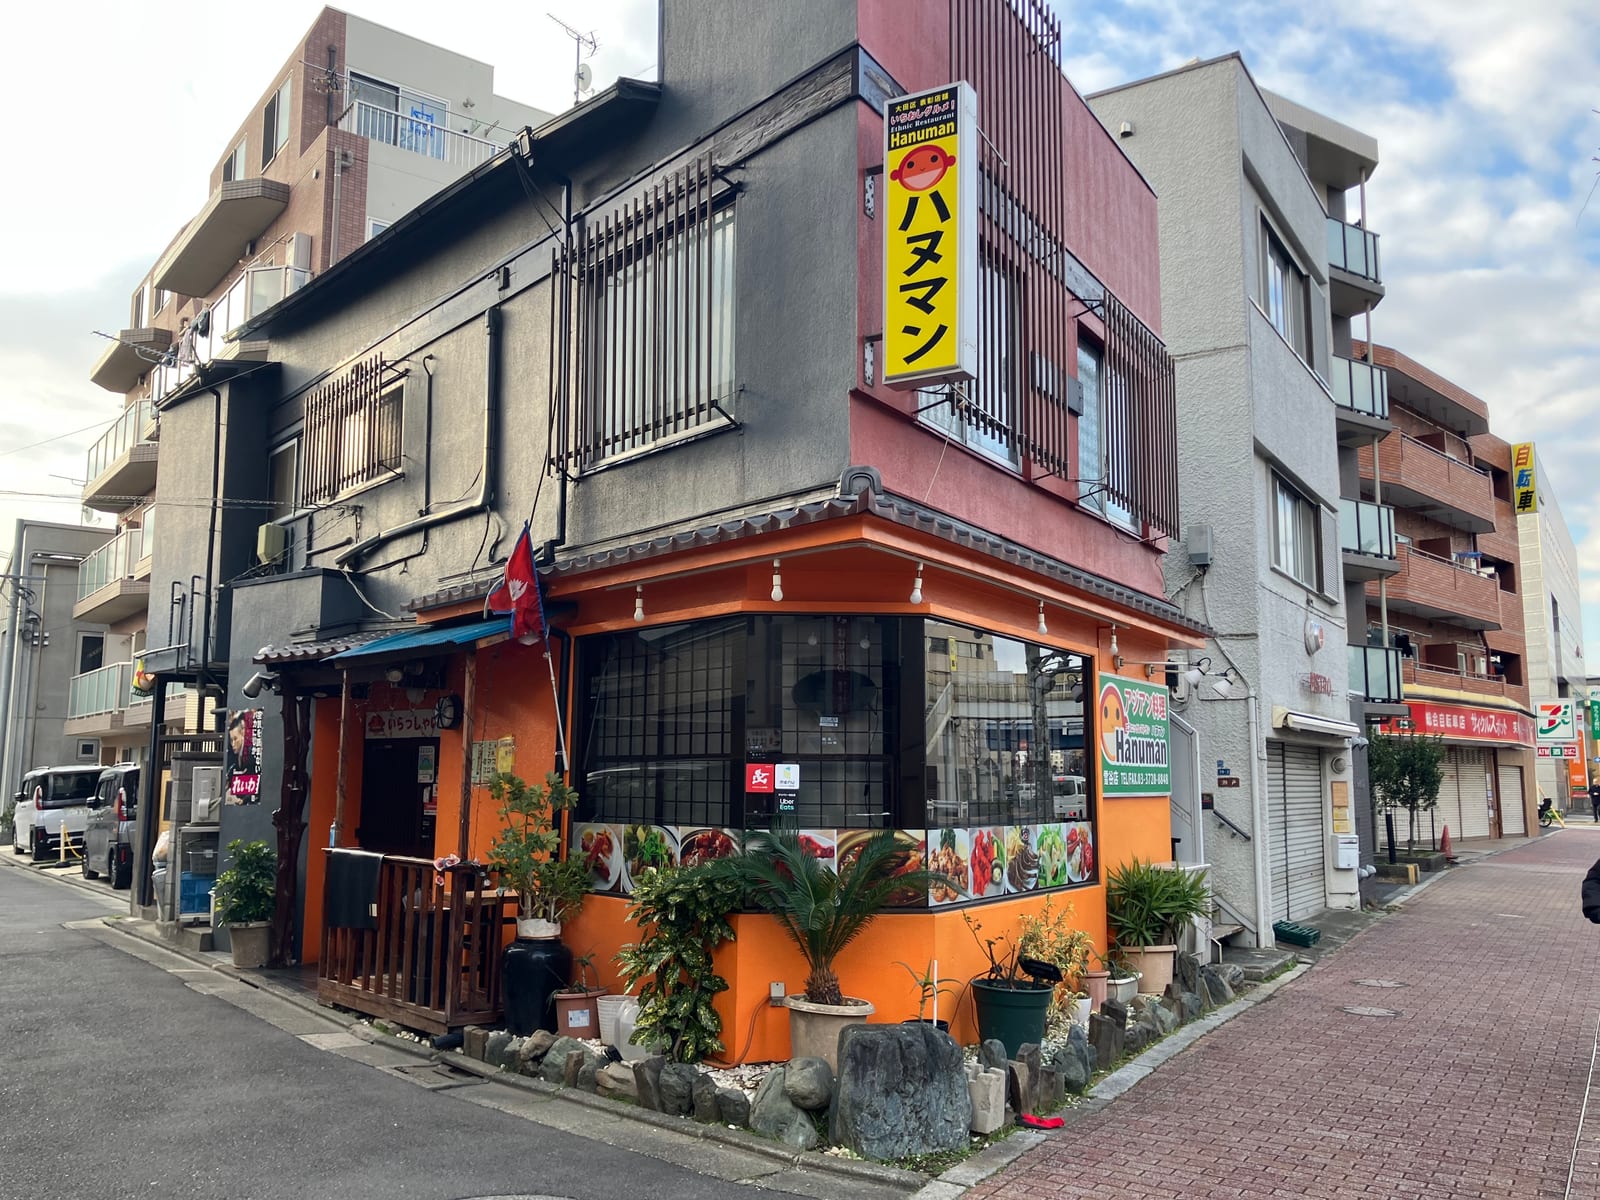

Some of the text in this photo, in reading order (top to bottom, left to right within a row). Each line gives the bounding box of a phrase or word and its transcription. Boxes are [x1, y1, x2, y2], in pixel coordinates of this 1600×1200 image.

[890, 121, 955, 148] Hanuman
[891, 112, 955, 133] Ethnic Restaurant
[898, 190, 952, 365] ハヌマン
[1515, 444, 1535, 512] 自転車
[1123, 688, 1166, 720] アジアン料理
[1115, 728, 1168, 766] Hanuman
[232, 777, 256, 794] れいわ
